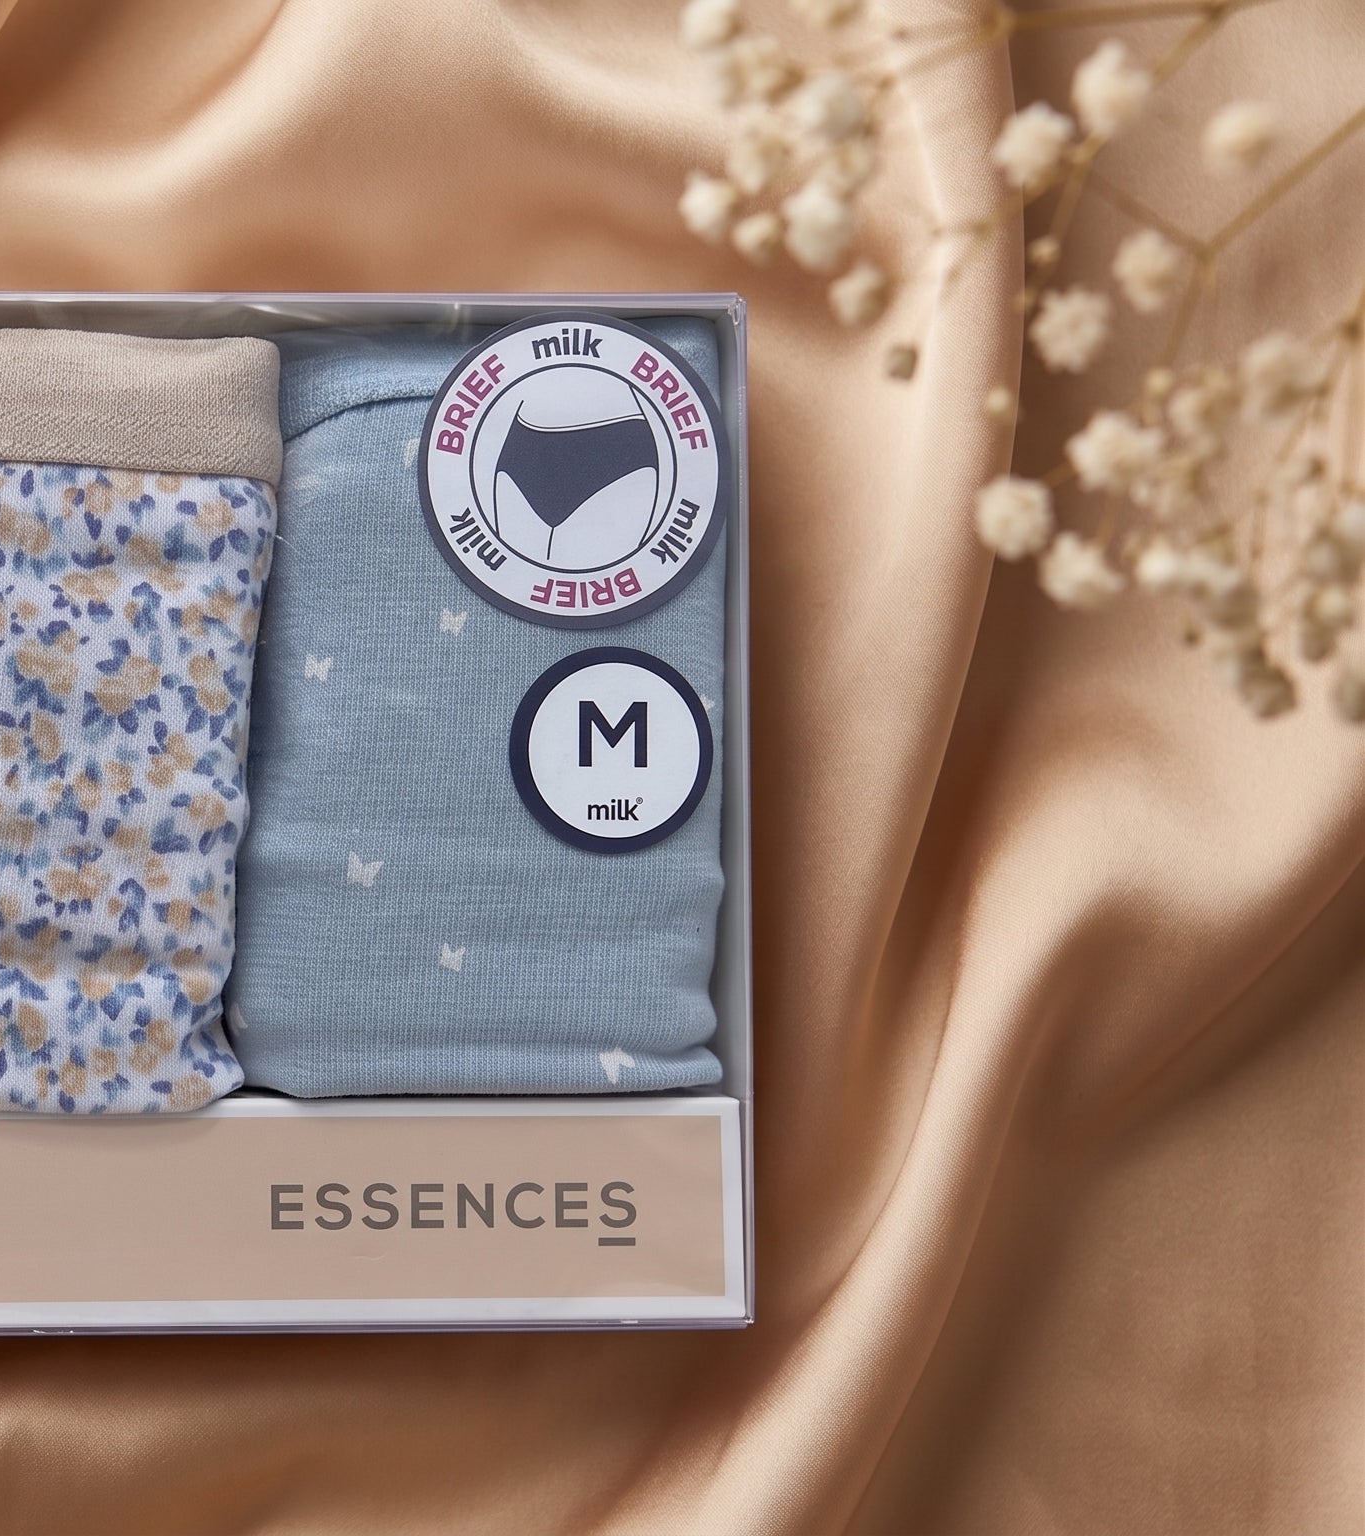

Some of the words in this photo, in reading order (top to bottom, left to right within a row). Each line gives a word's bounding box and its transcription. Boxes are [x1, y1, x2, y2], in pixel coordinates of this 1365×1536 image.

[532, 328, 603, 359] milk
[436, 353, 505, 455] BRIEF
[630, 351, 709, 450] BRIEF
[450, 507, 507, 572] milk
[650, 498, 700, 565] milk
[530, 567, 643, 609] BRIEF
[578, 700, 648, 768] M
[270, 1181, 637, 1231] ESSENCES
